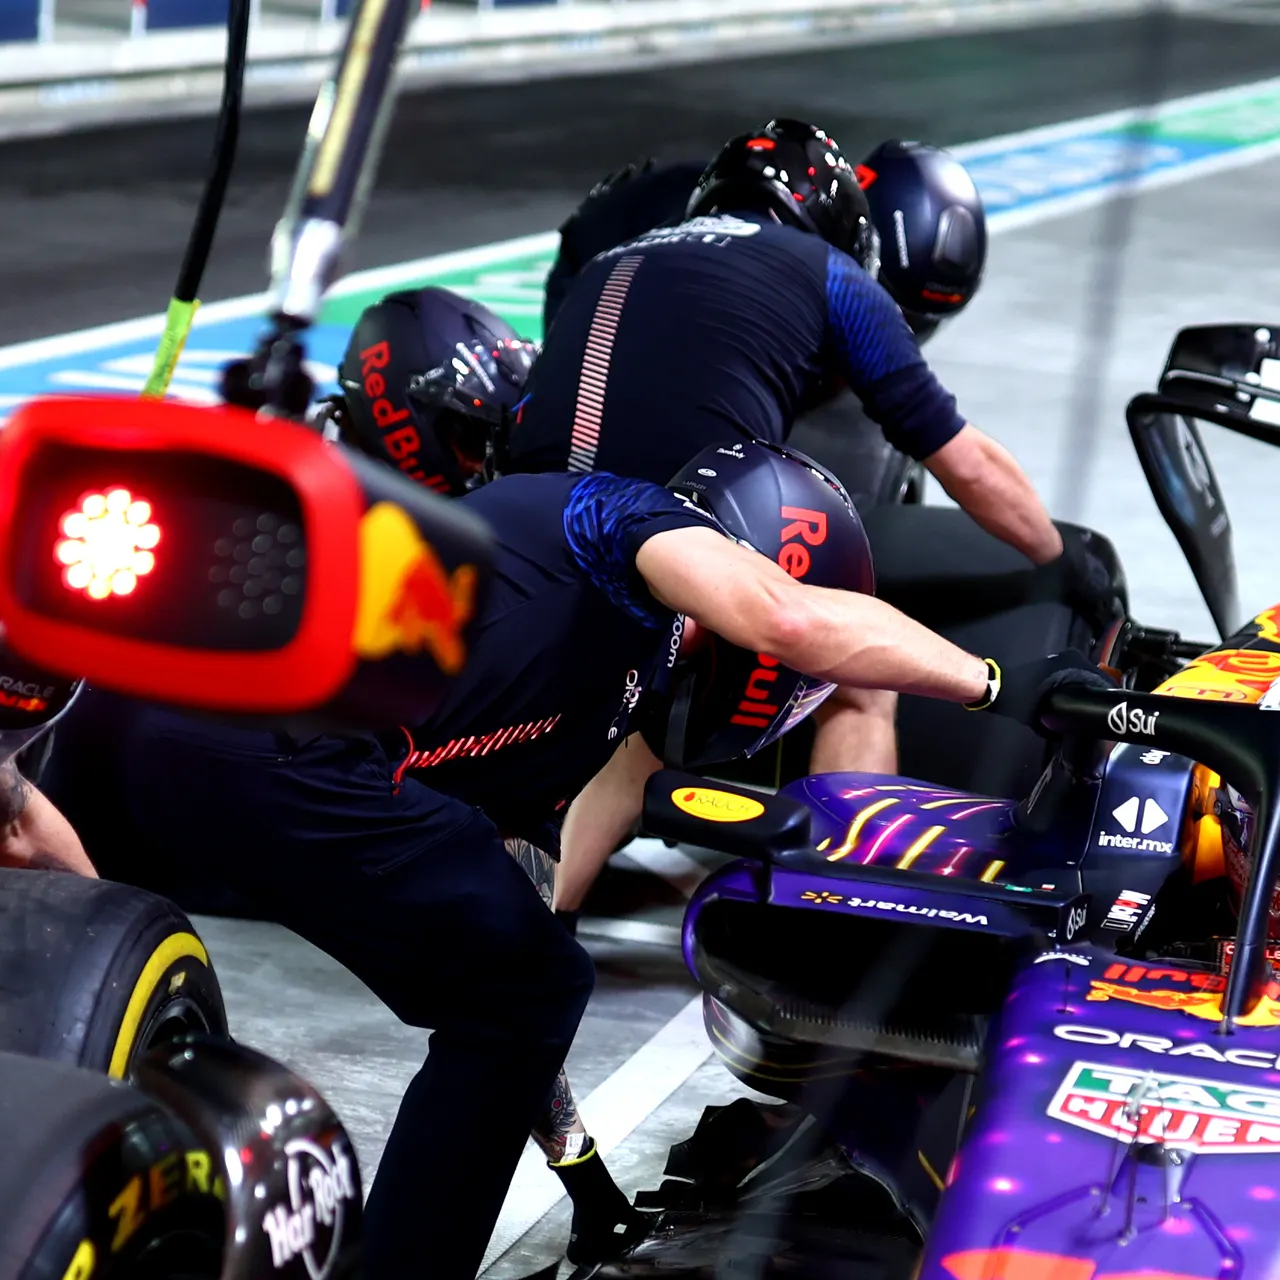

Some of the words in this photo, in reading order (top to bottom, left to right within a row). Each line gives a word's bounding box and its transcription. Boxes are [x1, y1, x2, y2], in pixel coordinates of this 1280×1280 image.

[360, 340, 411, 428] Red
[776, 505, 828, 579] Re
[1129, 708, 1159, 735] Sui
[1098, 831, 1174, 854] inter.mx
[847, 897, 988, 926] Walmart
[1107, 889, 1152, 922] Mobil
